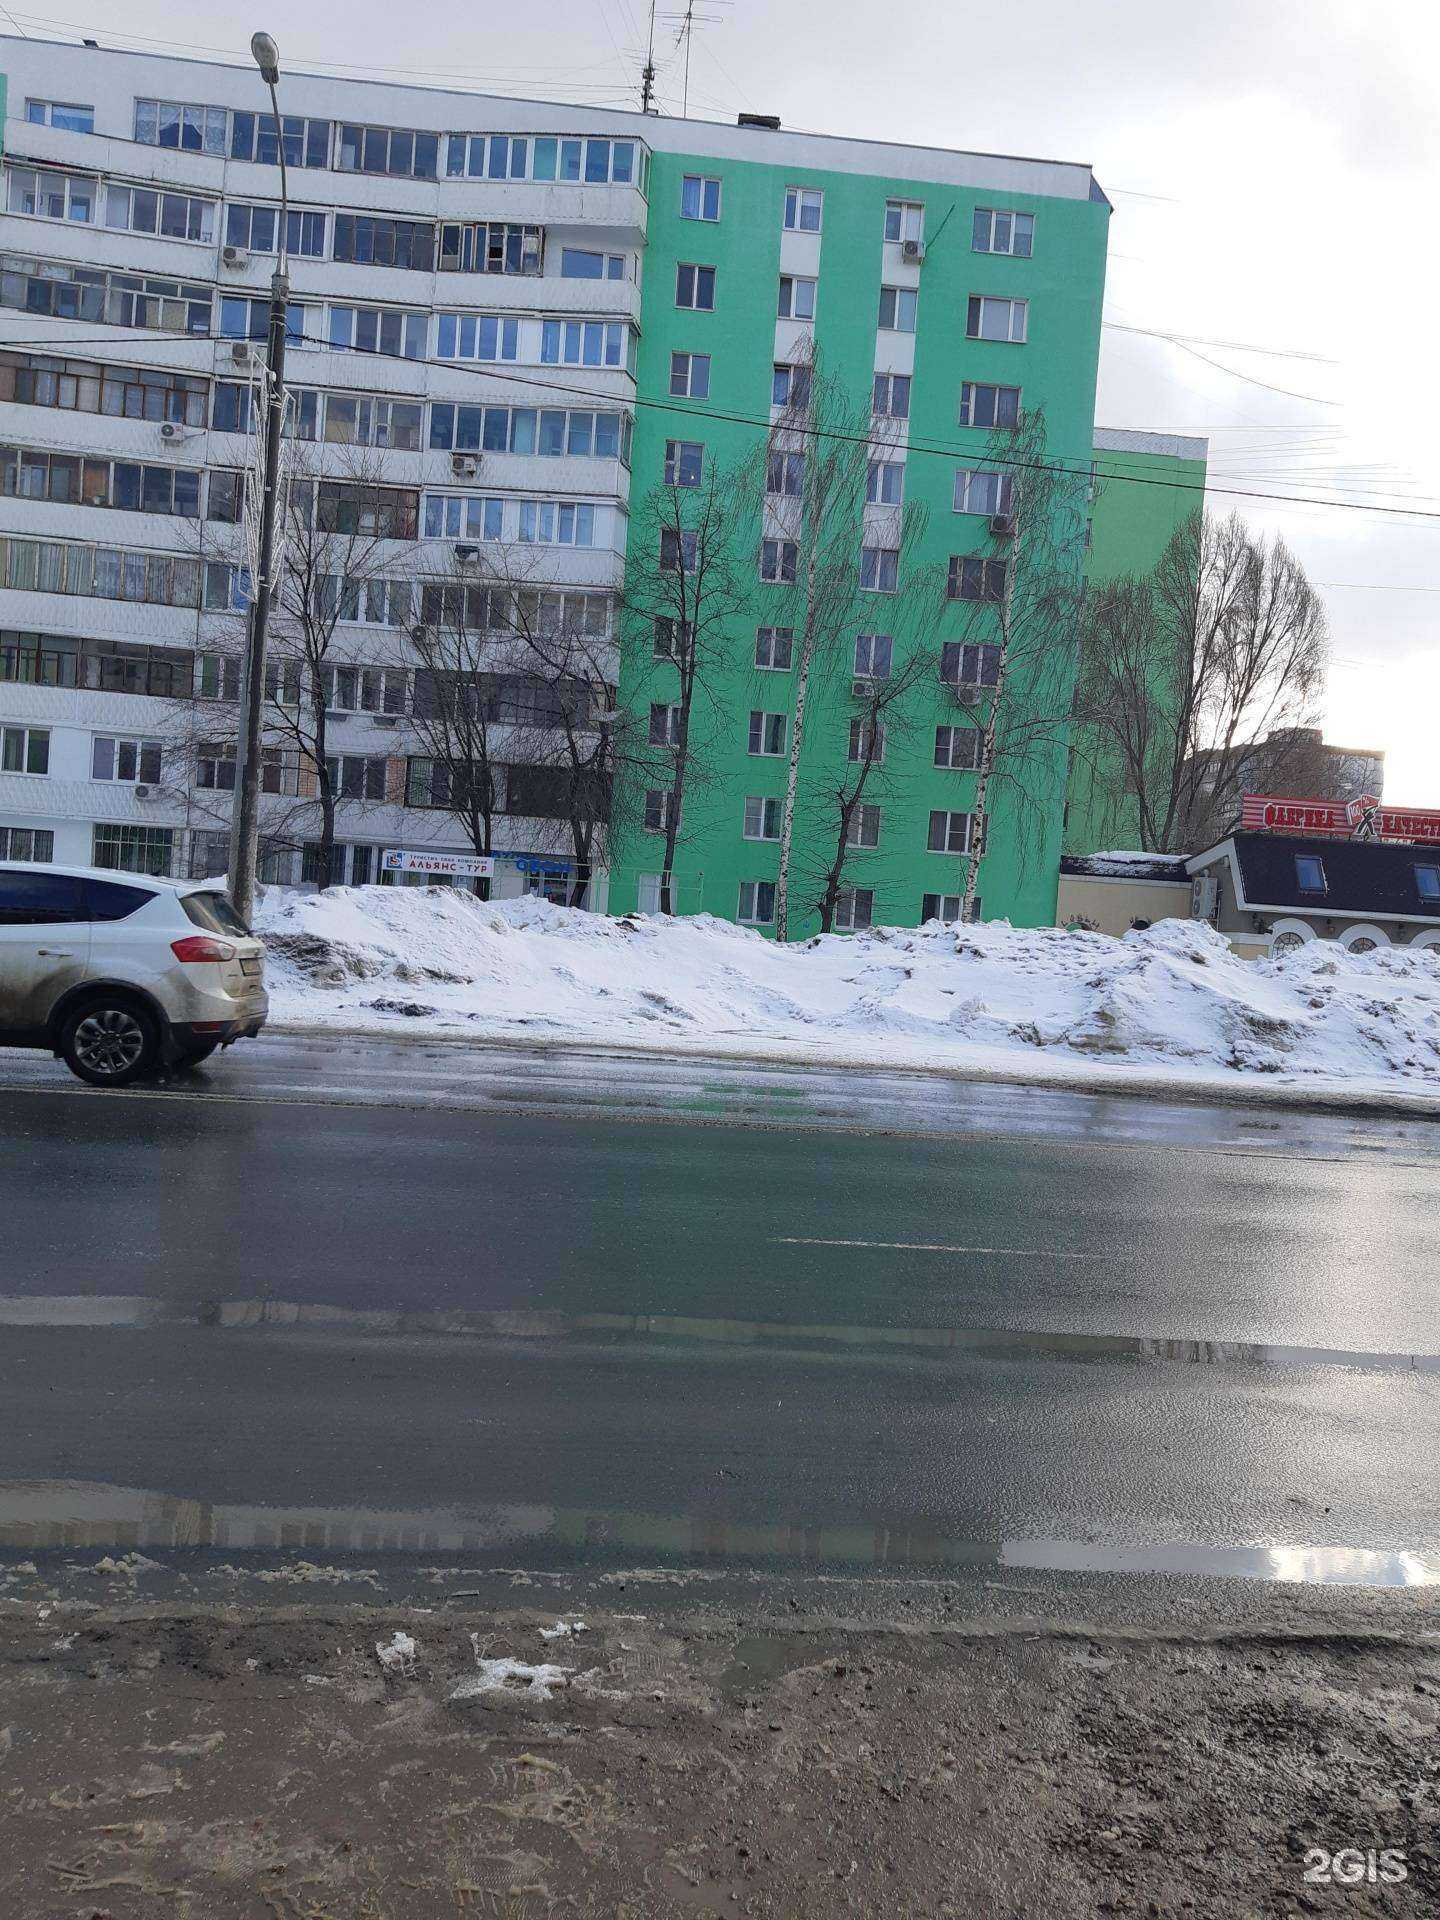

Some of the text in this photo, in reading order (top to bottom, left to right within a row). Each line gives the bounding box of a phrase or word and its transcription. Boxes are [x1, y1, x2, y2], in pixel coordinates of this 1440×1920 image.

[1263, 803, 1335, 829] ФАБРИКА
[409, 860, 457, 871] АЛЬЯНС
[466, 864, 487, 872] ТУР
